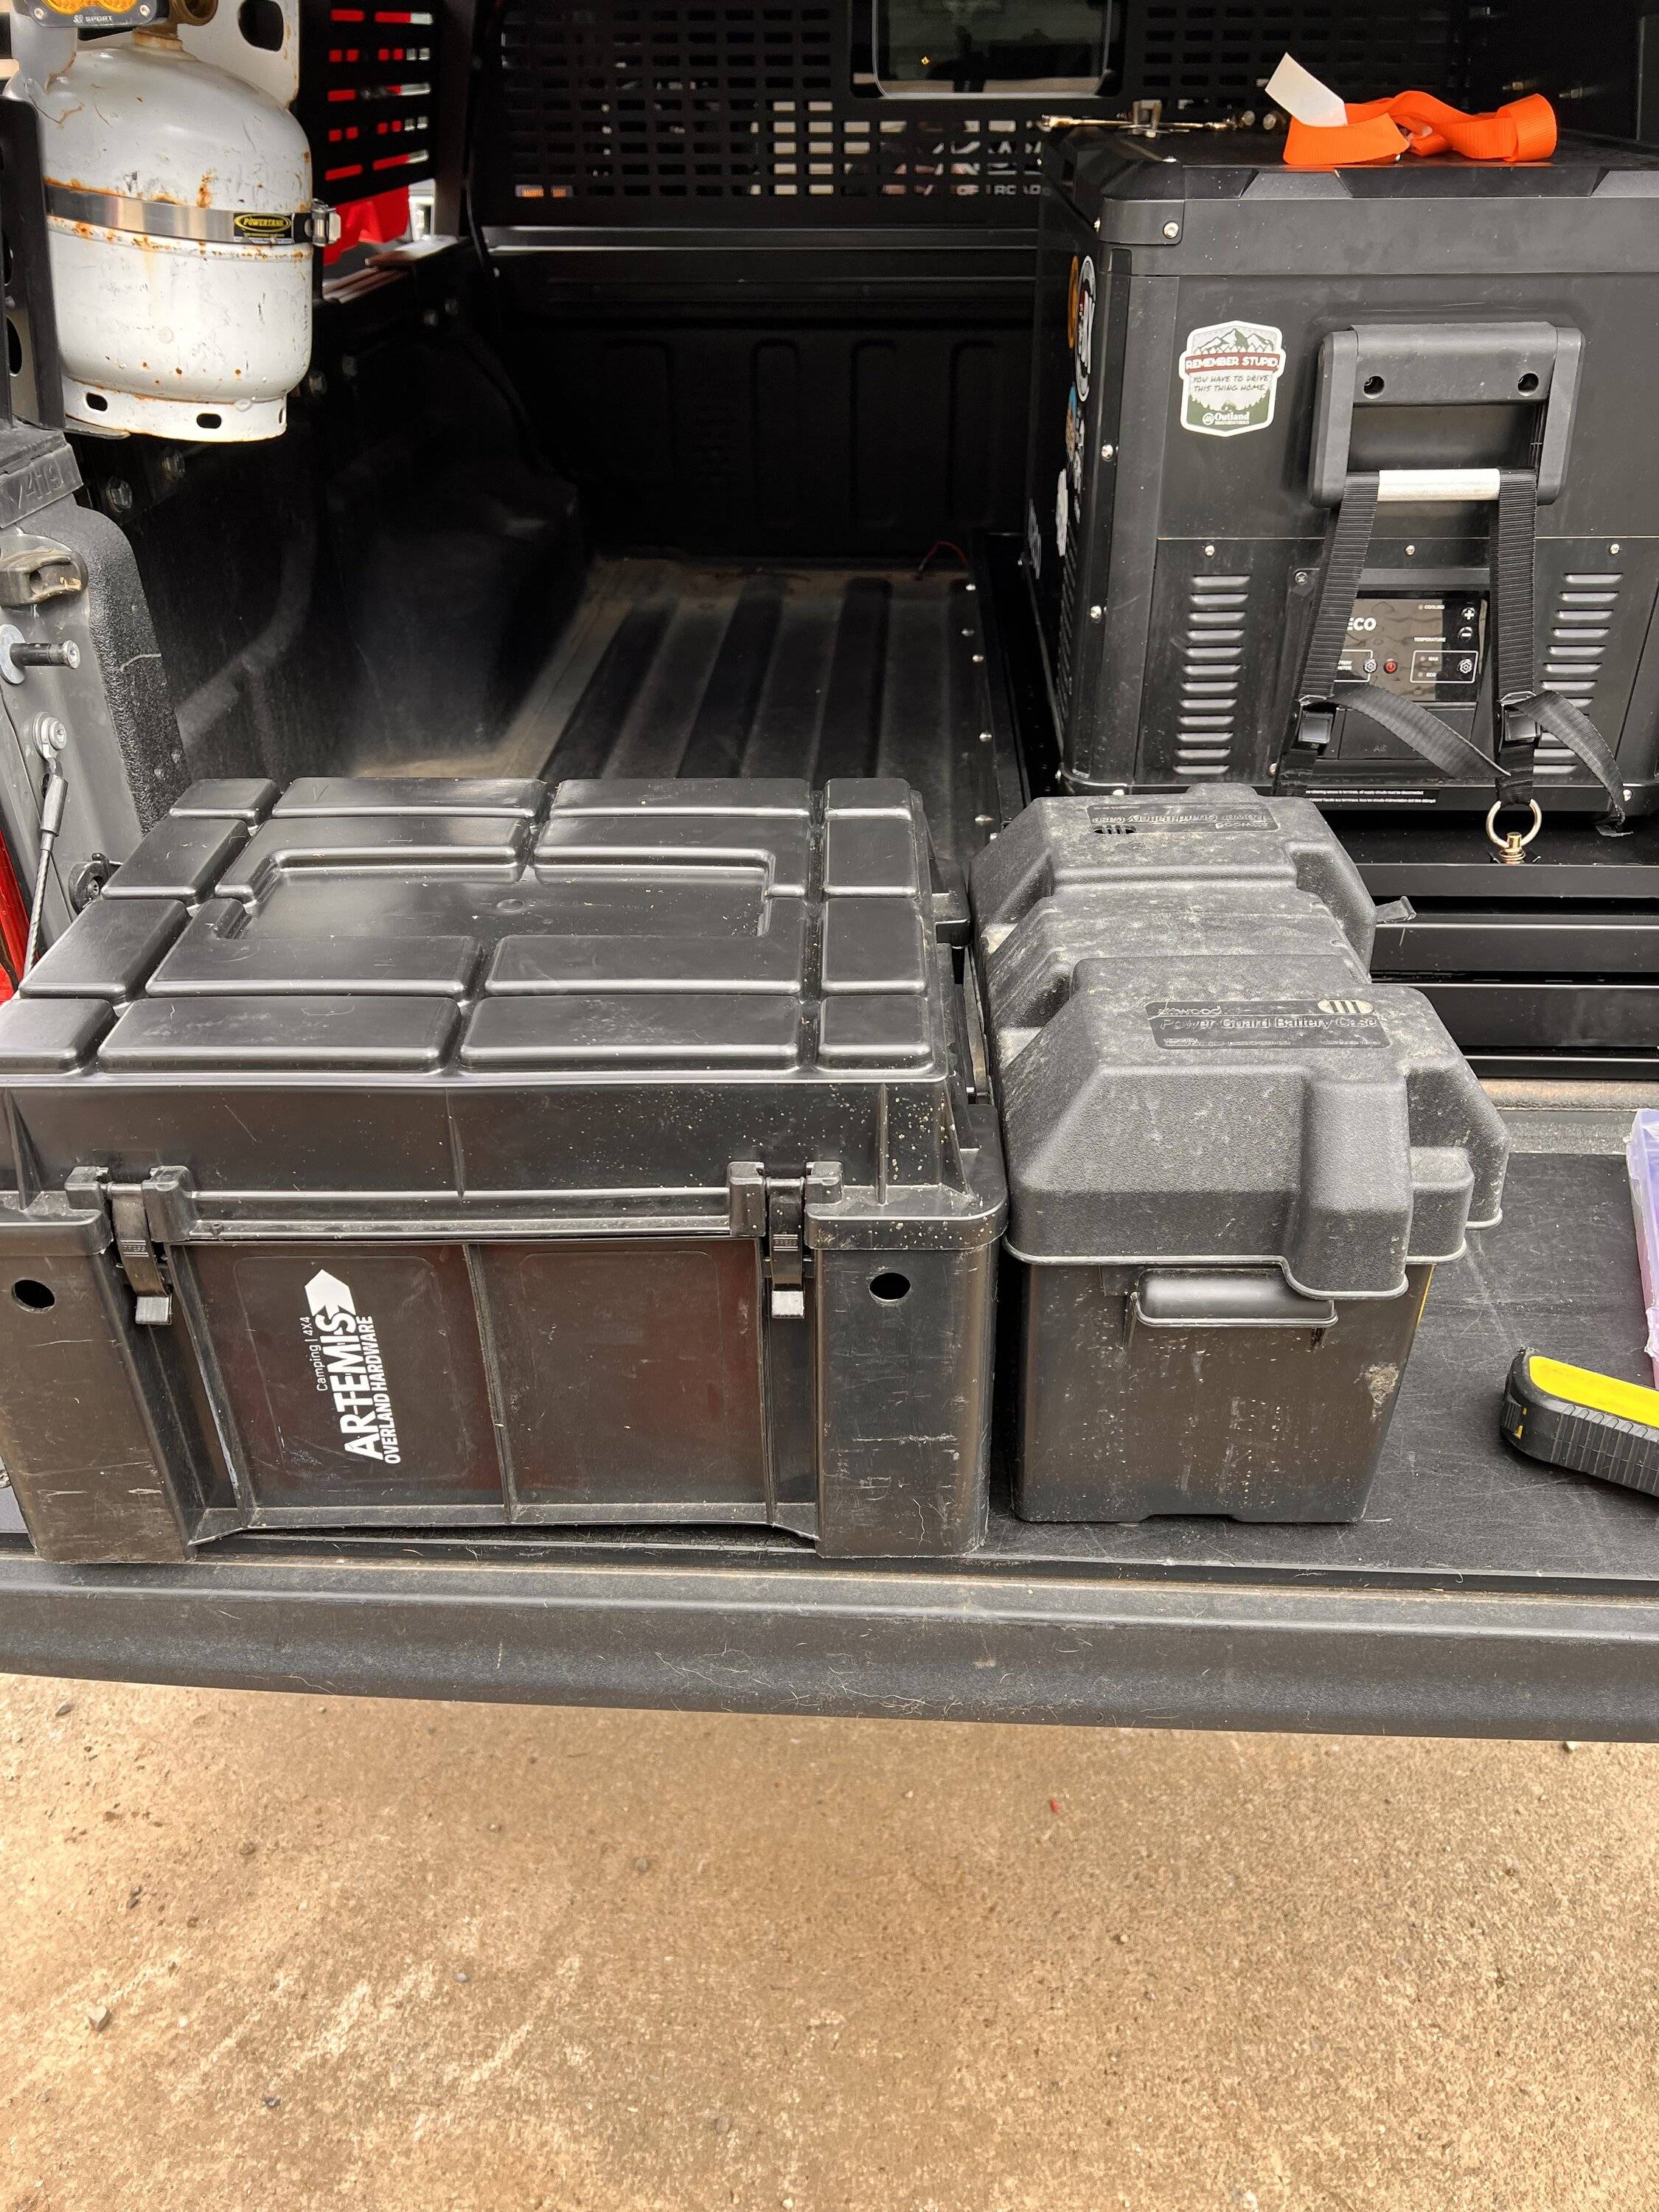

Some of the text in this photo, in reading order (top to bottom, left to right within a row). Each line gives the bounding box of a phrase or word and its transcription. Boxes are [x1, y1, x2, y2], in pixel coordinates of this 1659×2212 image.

[1186, 357, 1240, 369] REMEMBER
[1194, 375, 1209, 383] YOU
[1246, 374, 1269, 382] DRIVE
[1214, 411, 1251, 421] Outland
[1160, 1016, 1378, 1030] Power Guard Battery Case
[309, 1344, 328, 1391] Camping
[315, 1312, 384, 1461] ARTEMIS
[355, 1315, 401, 1464] OVERLAND HARDWARE
